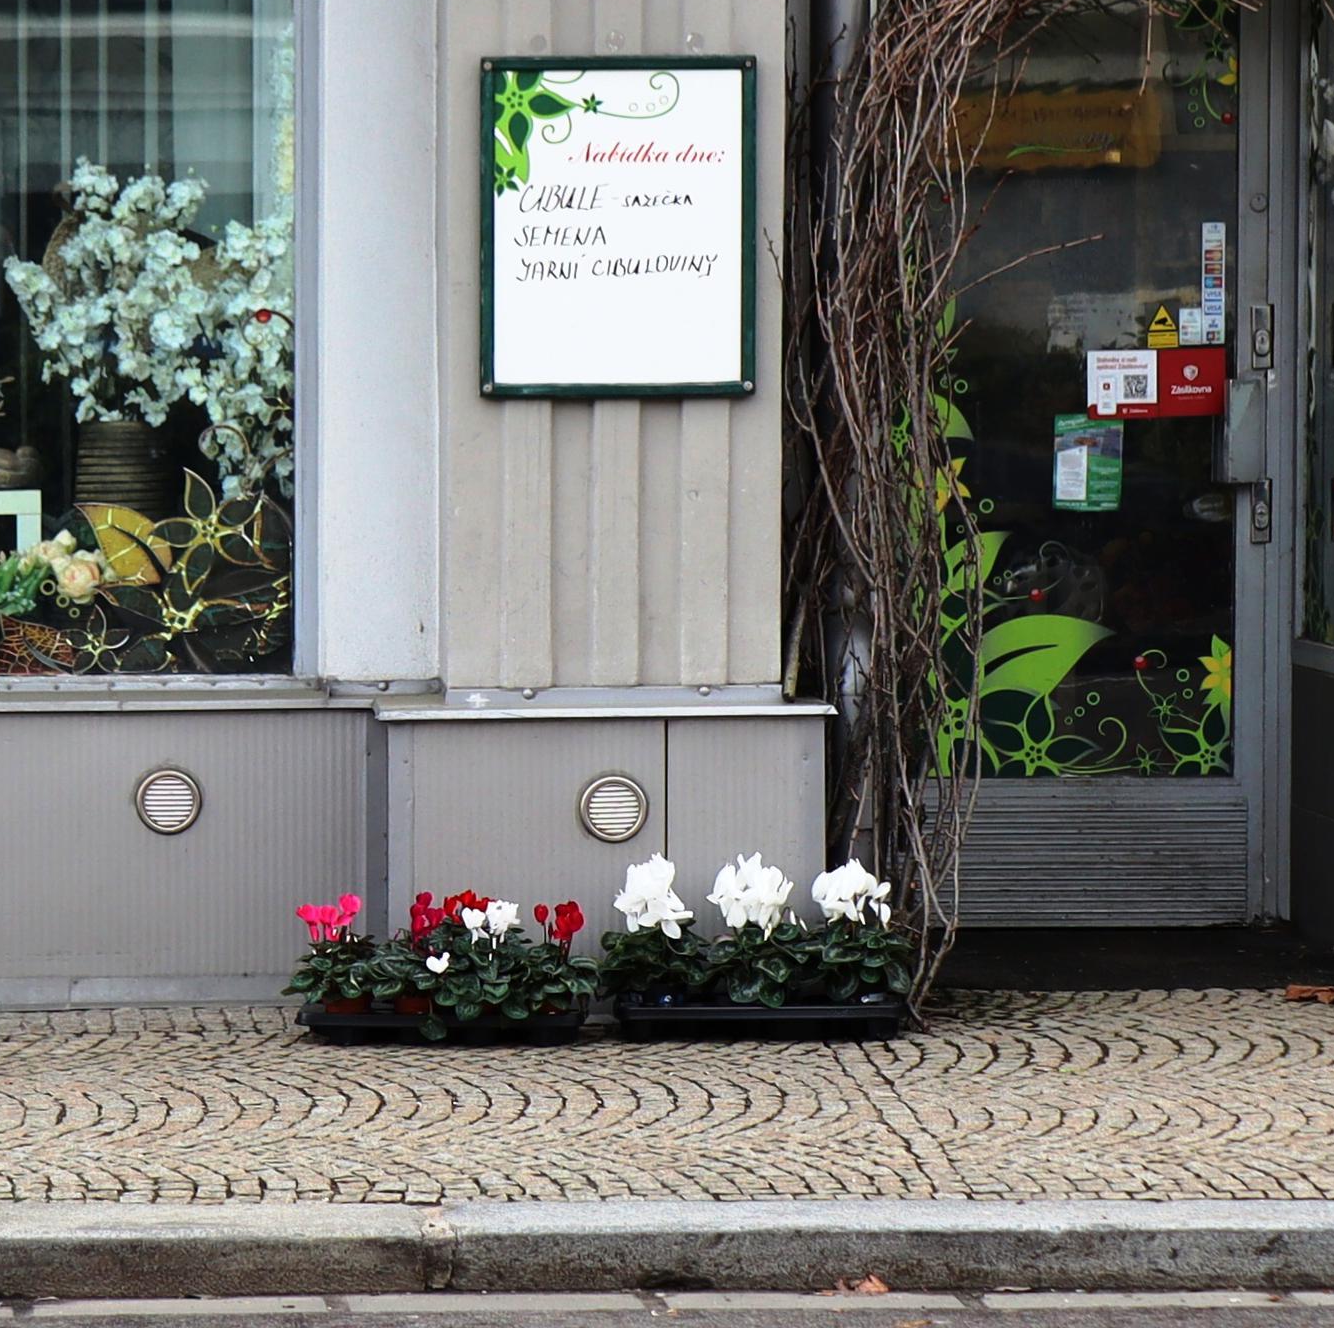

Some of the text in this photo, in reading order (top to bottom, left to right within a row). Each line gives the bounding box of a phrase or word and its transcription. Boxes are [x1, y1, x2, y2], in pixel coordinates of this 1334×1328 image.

[568, 141, 726, 163] Nabídka dne:
[519, 184, 609, 213] CIBULE
[513, 225, 607, 248] SEMENA
[591, 254, 719, 279] CIBULOVINY
